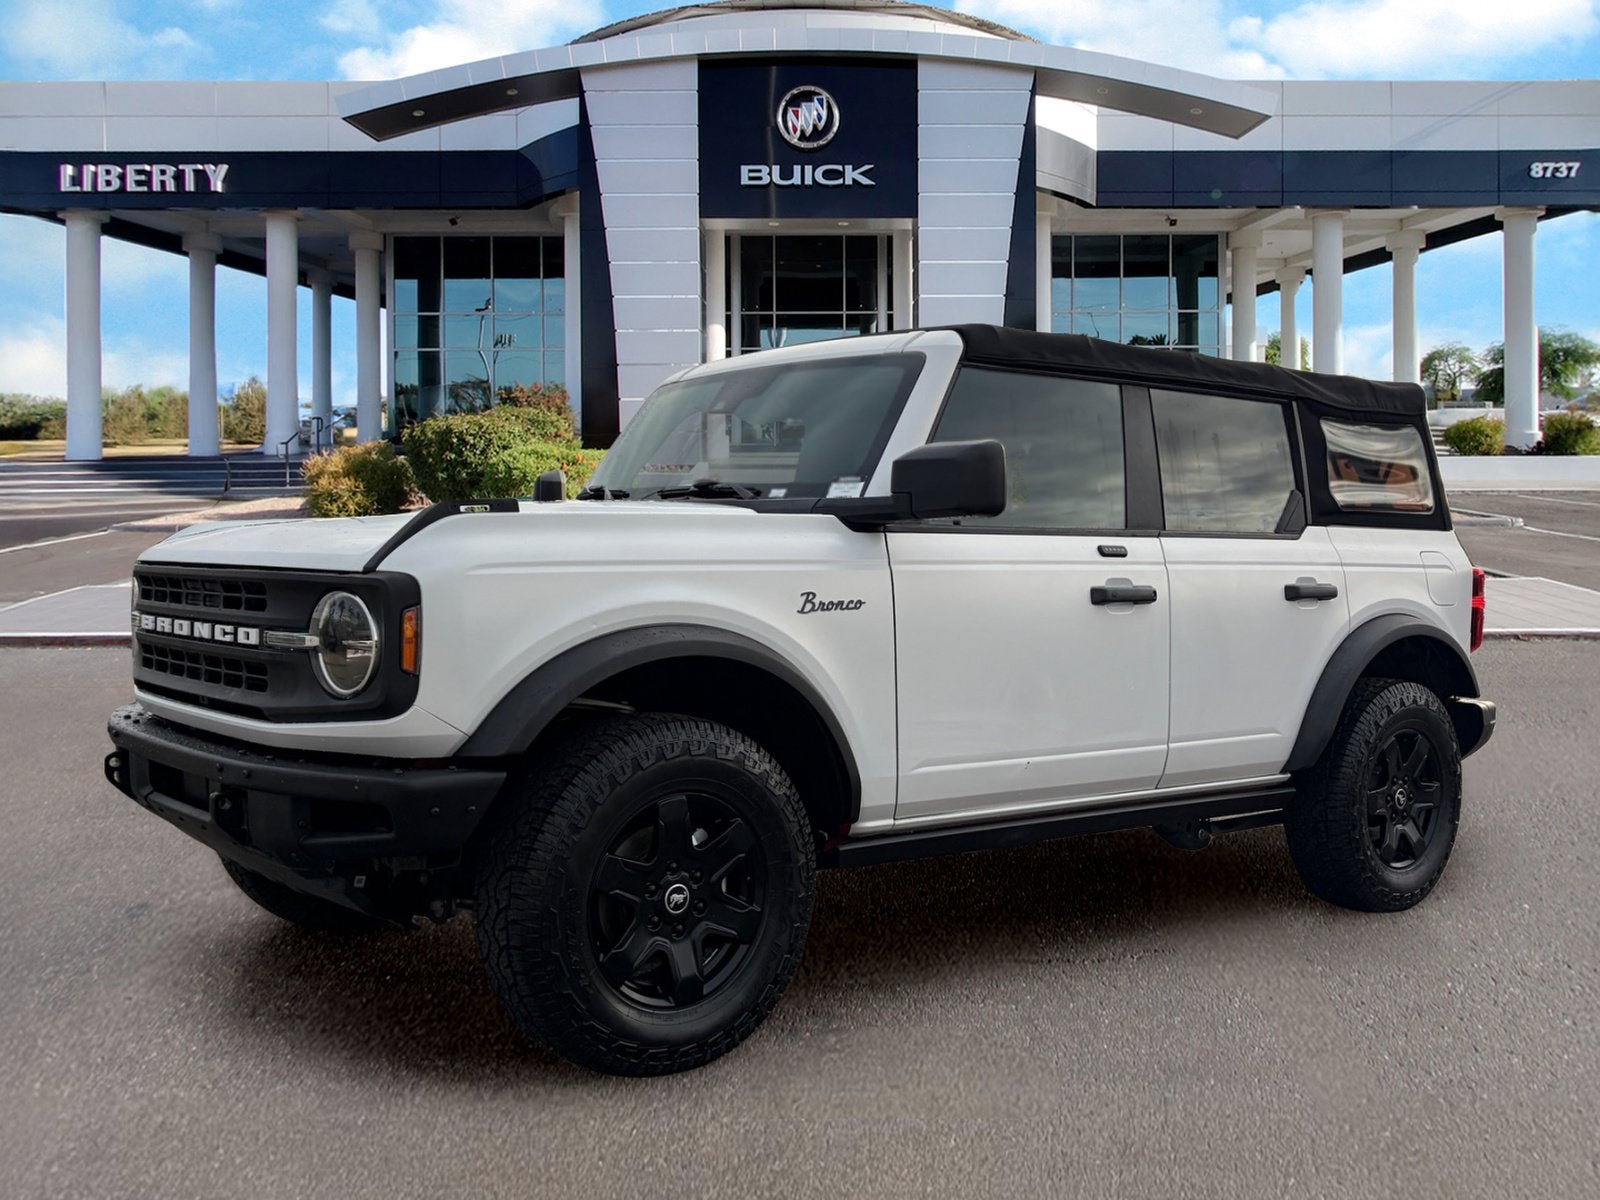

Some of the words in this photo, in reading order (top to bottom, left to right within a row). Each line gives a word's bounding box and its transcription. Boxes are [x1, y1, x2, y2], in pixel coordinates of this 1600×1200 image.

[59, 164, 229, 192] LIBERTY
[740, 164, 876, 186] BUICK
[1529, 162, 1580, 178] 8737
[797, 591, 866, 615] Bronco
[140, 613, 260, 645] BRONCO
